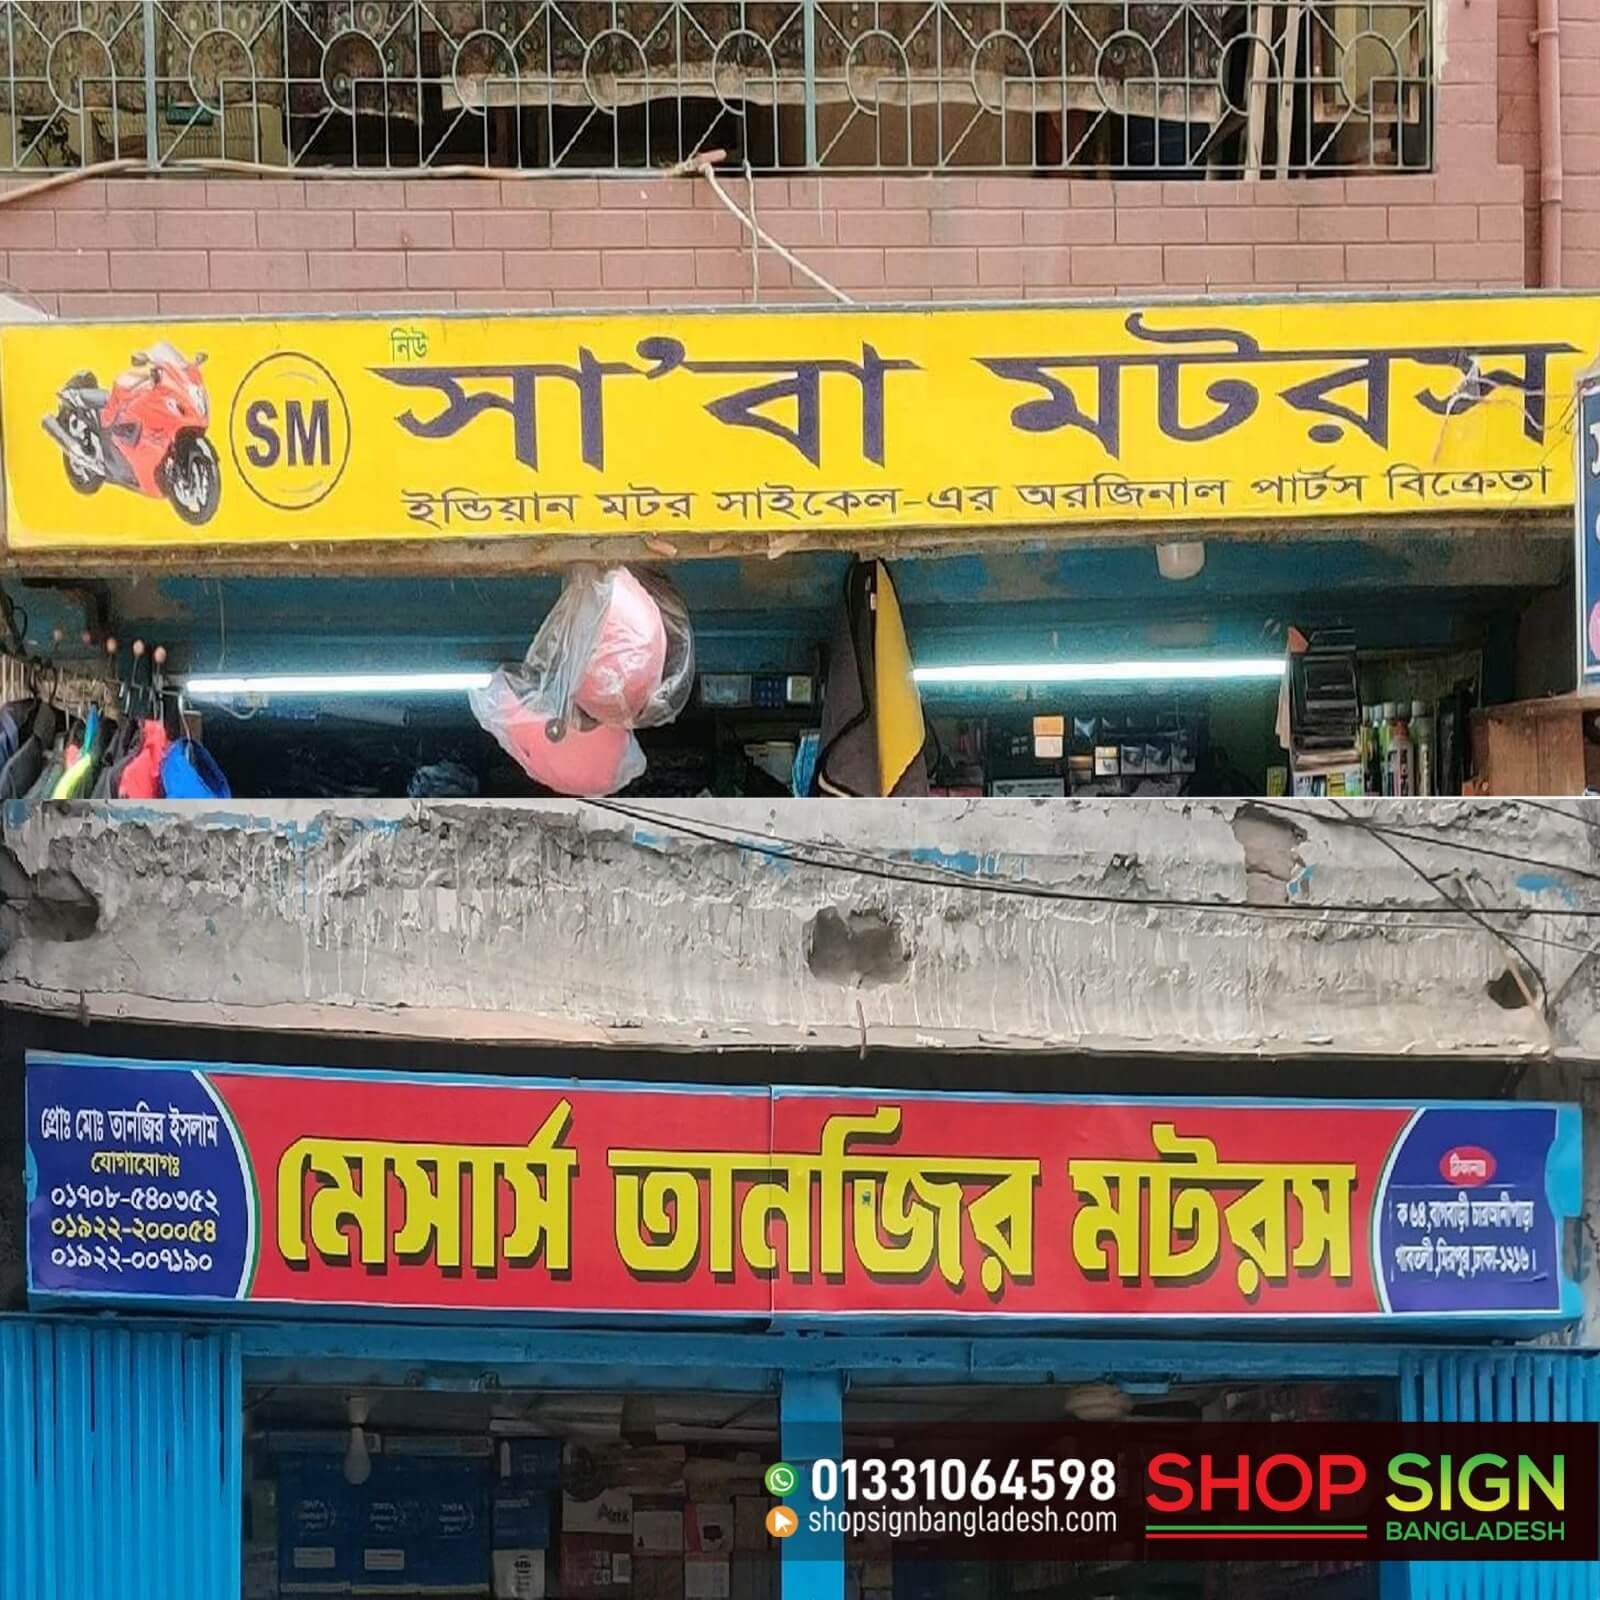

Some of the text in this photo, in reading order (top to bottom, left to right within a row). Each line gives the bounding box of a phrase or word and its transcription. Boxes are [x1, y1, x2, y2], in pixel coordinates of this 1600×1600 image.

[390, 327, 429, 361] নিউ
[971, 312, 1582, 458] মটরস
[245, 400, 331, 467] SM
[402, 487, 582, 530] ইন্ডিয়ান
[594, 483, 698, 521] মটর
[1014, 473, 1231, 512] অরজিনাল
[1250, 464, 1369, 504] পার্টস
[1385, 463, 1552, 501] বিক্রেতা
[75, 1108, 104, 1142] মোঃ
[108, 1100, 166, 1145] তানজির
[168, 1101, 219, 1147] ইসলাম
[90, 1151, 181, 1177] যোগাযোগঃ
[50, 1184, 220, 1216] ০১৭০৮-৫৪০৩৫২
[277, 1099, 1357, 1298] মেসার্স তানজির মটরস
[50, 1213, 218, 1244] ০১৯২২-২০০০৫৪
[50, 1243, 214, 1272] ০১৯২২-০০৭১৯০
